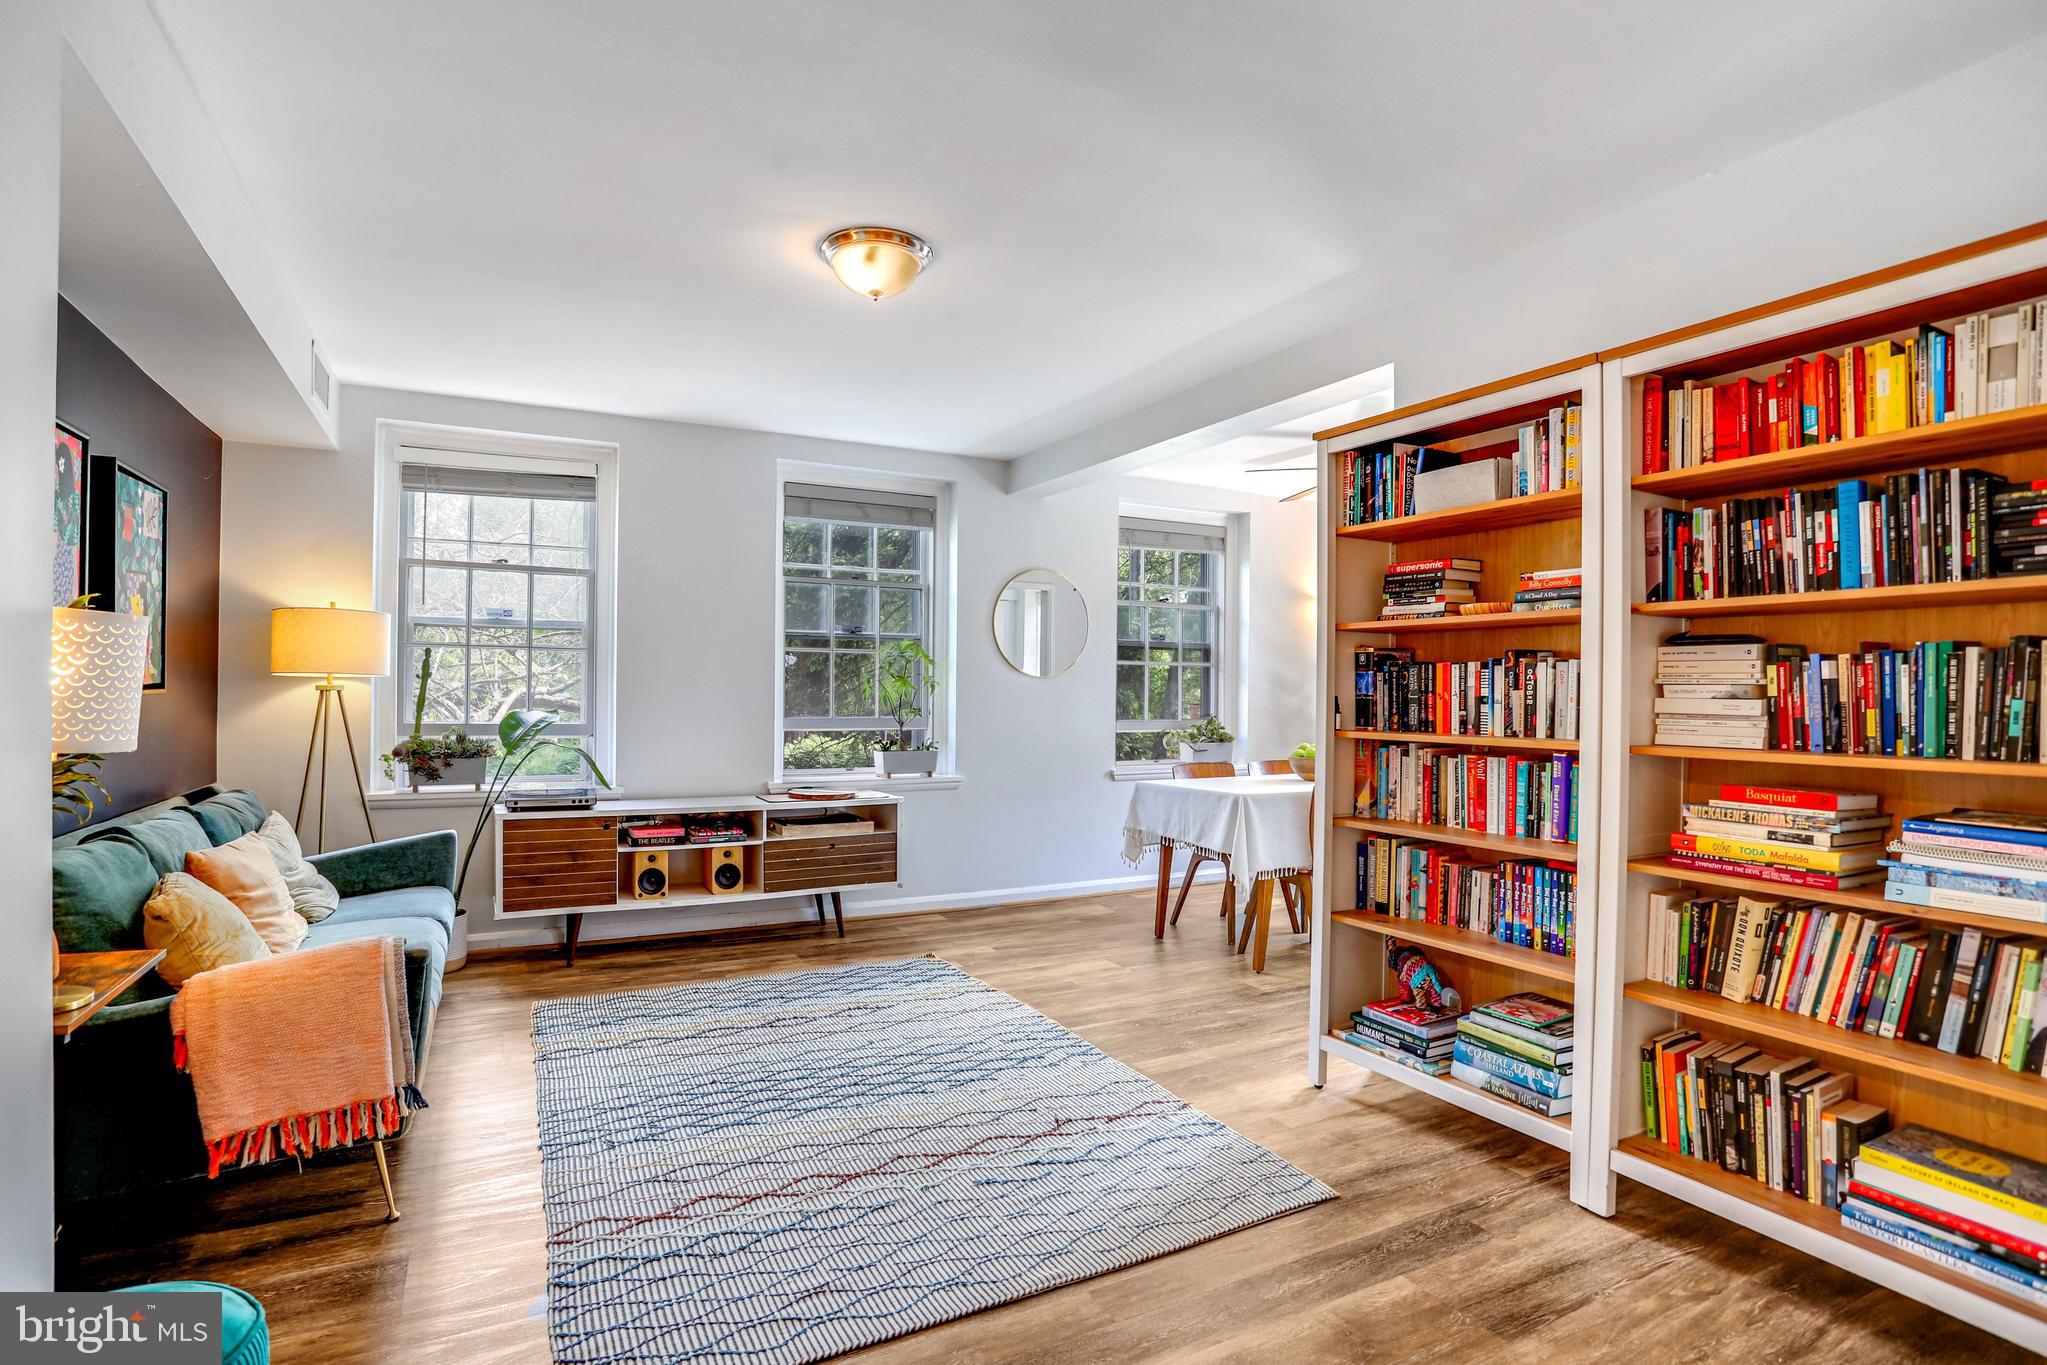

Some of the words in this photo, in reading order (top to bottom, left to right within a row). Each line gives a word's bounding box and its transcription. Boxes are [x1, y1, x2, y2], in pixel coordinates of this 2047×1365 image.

[1396, 560, 1443, 573] supersonic
[1528, 580, 1542, 589] Billy
[1544, 577, 1572, 587] Connolly
[1552, 602, 1572, 610] Here
[1526, 669, 1534, 705] OCTOBER
[1476, 759, 1486, 780] Wolf
[1553, 784, 1561, 802] Flood
[1745, 789, 1797, 804] Basquiat
[1690, 805, 1746, 823] MICKALENE
[1747, 810, 1794, 827] THOMAS
[1928, 825, 1964, 835] Argentina
[1677, 850, 1721, 860] FRACTALS
[1739, 846, 1766, 857] TODA
[1769, 851, 1809, 864] Mafalda
[1694, 861, 1722, 872] SYMPATHY
[1722, 864, 1733, 872] FOR
[1733, 866, 1745, 874] THE
[1745, 867, 1761, 876] DEVIL
[1737, 918, 1749, 936] DON
[1730, 937, 1745, 974] QUIXOTE
[1356, 1023, 1385, 1042] HUMANS
[1370, 1022, 1382, 1031] GREAT
[1467, 1045, 1509, 1069] COASTAL
[1511, 1063, 1544, 1080] ATLAS
[1485, 1061, 1515, 1078] IRELAND
[1491, 1084, 1517, 1101] FAMINE
[1900, 1164, 1932, 1177] HISTORY
[1945, 1178, 1980, 1195] IRELAND
[1982, 1191, 1991, 1199] IN
[1992, 1195, 2016, 1208] MAPS
[1854, 1209, 1873, 1221] THE
[1876, 1217, 1906, 1236] HOOK
[1908, 1230, 1960, 1258] PENINSULA
[1848, 1219, 1911, 1247] WEXFORD
[1911, 1240, 1969, 1272] CASTLES
